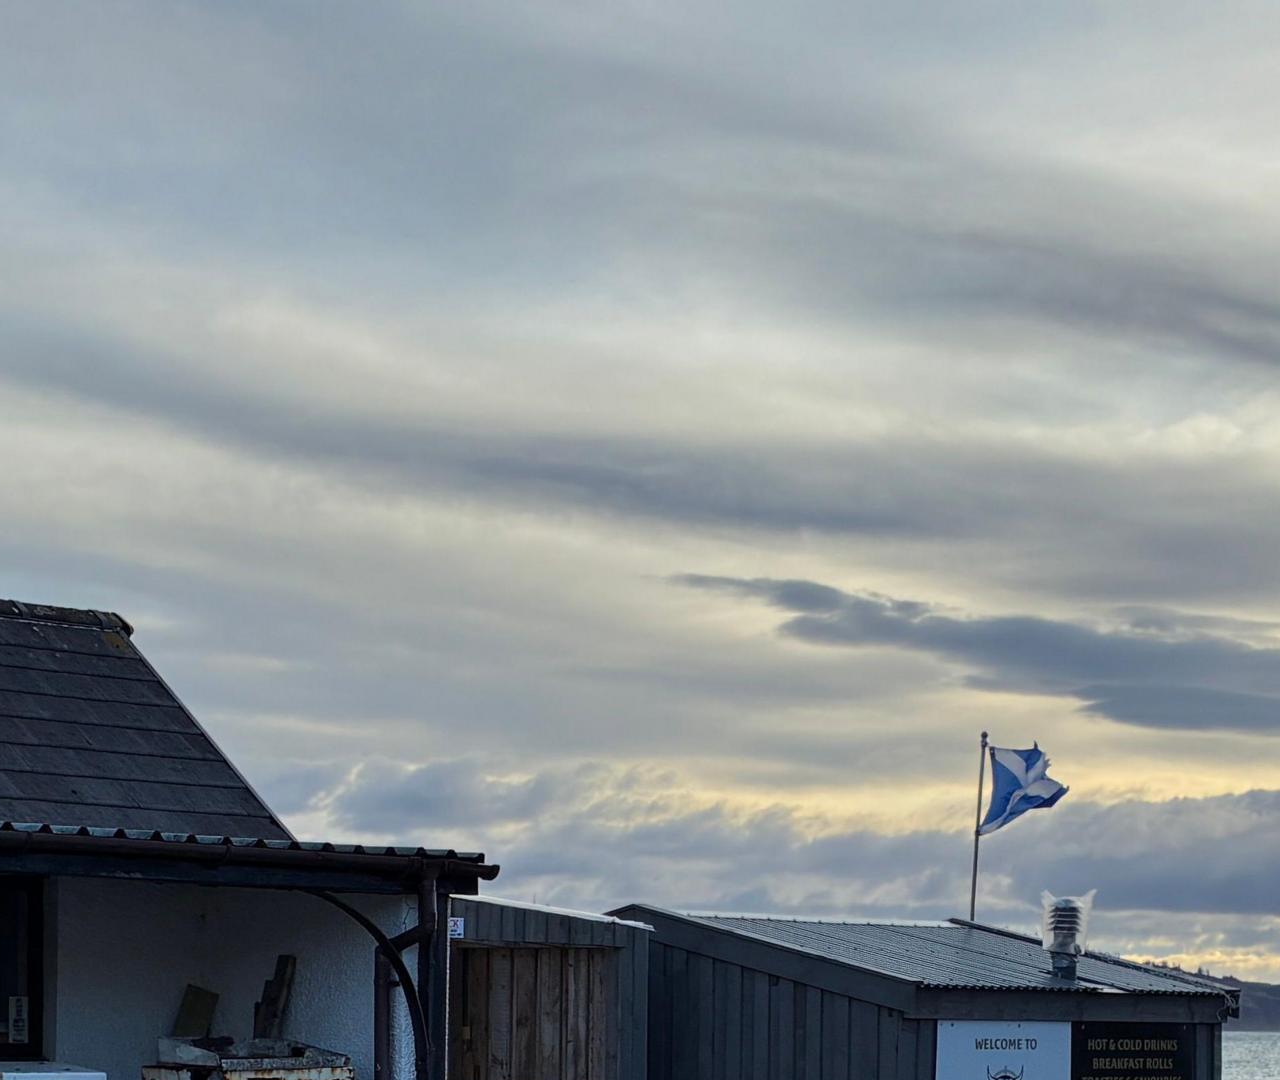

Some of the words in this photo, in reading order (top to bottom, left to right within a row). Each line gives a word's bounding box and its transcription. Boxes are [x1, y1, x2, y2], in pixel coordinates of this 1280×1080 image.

[975, 1038, 1024, 1050] WELCOME
[1025, 1038, 1037, 1050] TO
[1087, 1039, 1108, 1051] HOT
[1108, 1039, 1116, 1051] &
[1117, 1039, 1143, 1051] COLD
[1144, 1038, 1178, 1051] DRINKS
[1092, 1057, 1145, 1070] BREAKFAST
[1146, 1057, 1174, 1070] ROLLS
